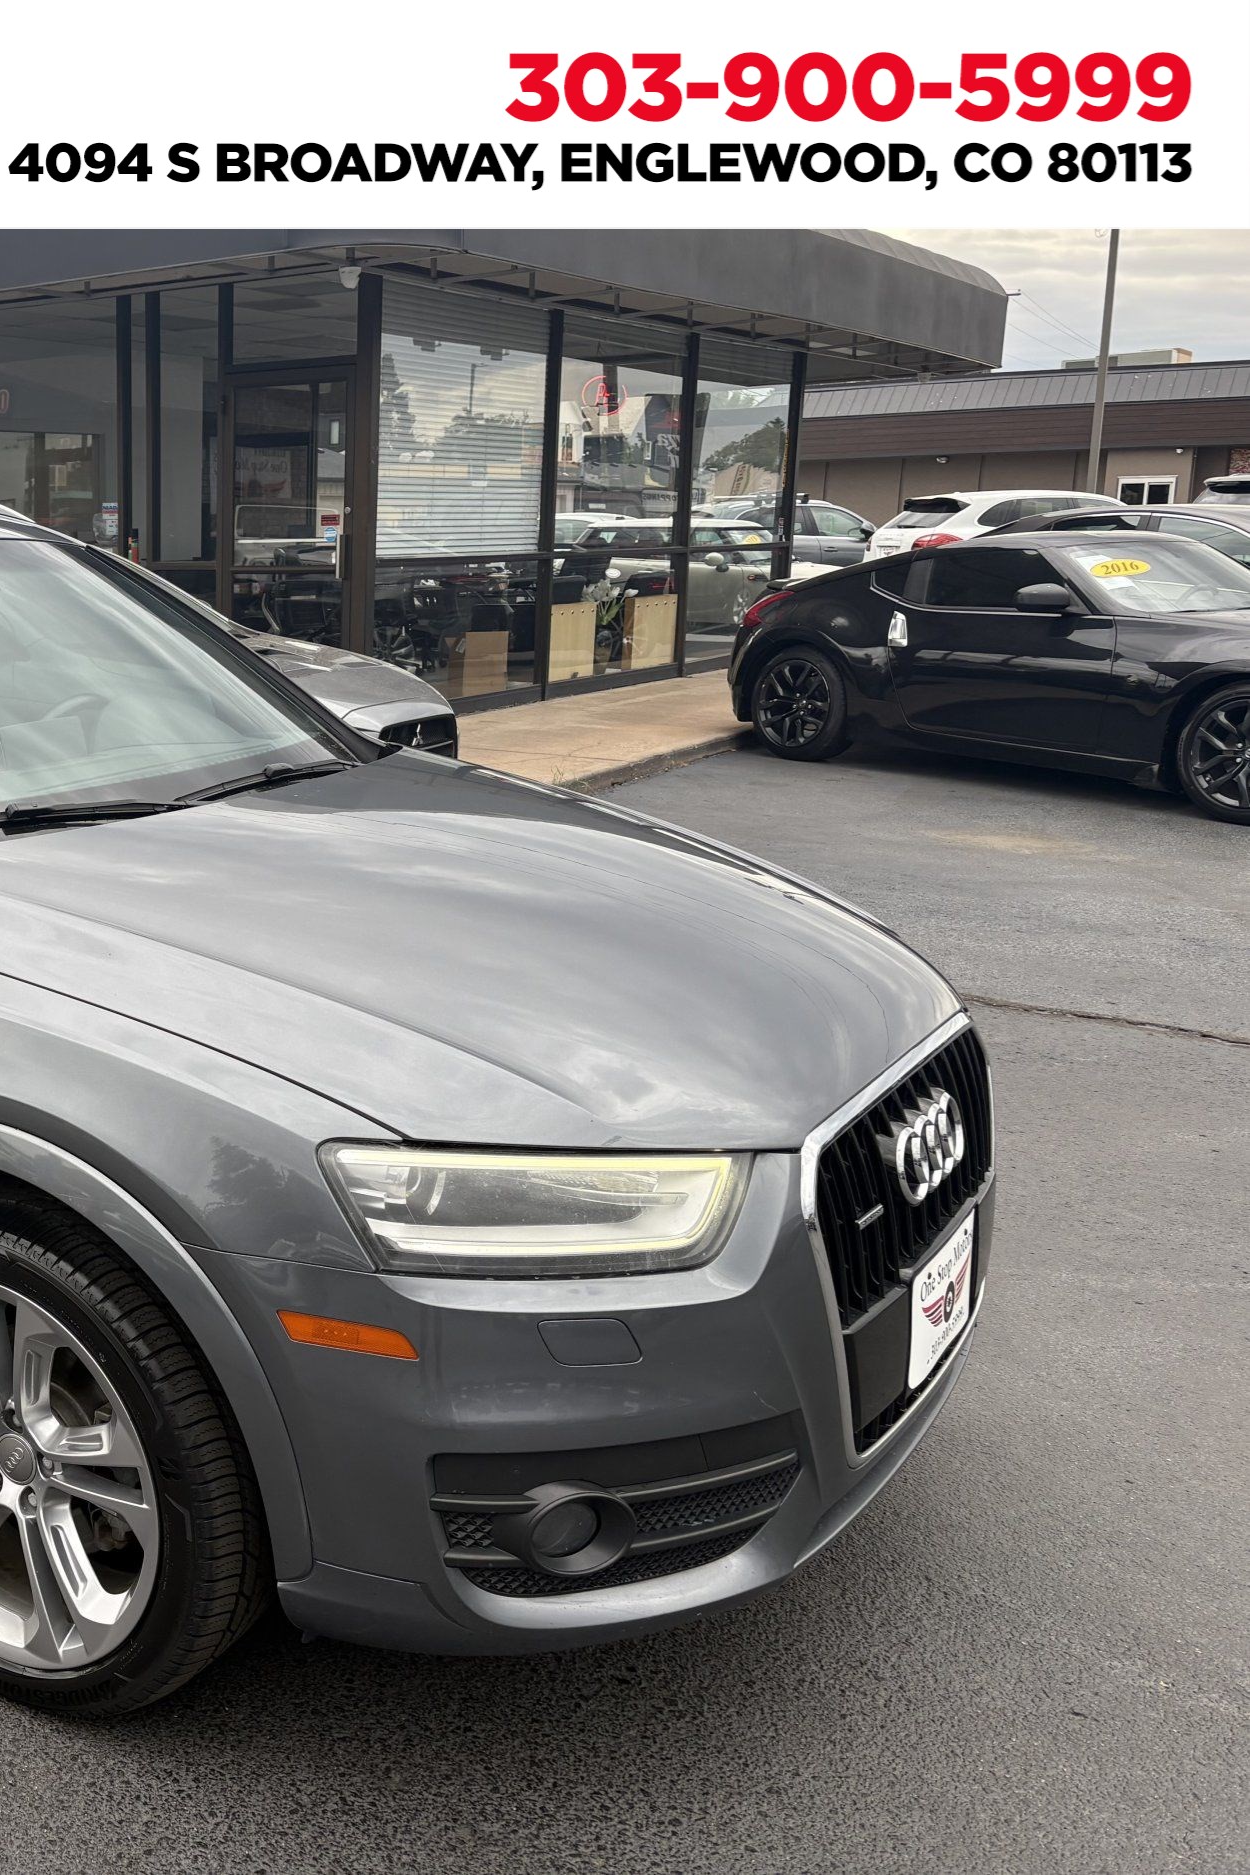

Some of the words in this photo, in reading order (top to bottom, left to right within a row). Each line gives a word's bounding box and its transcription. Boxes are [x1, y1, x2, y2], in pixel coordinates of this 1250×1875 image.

[1101, 561, 1139, 575] 2016
[920, 1277, 936, 1302] One
[937, 1259, 953, 1285] Stop
